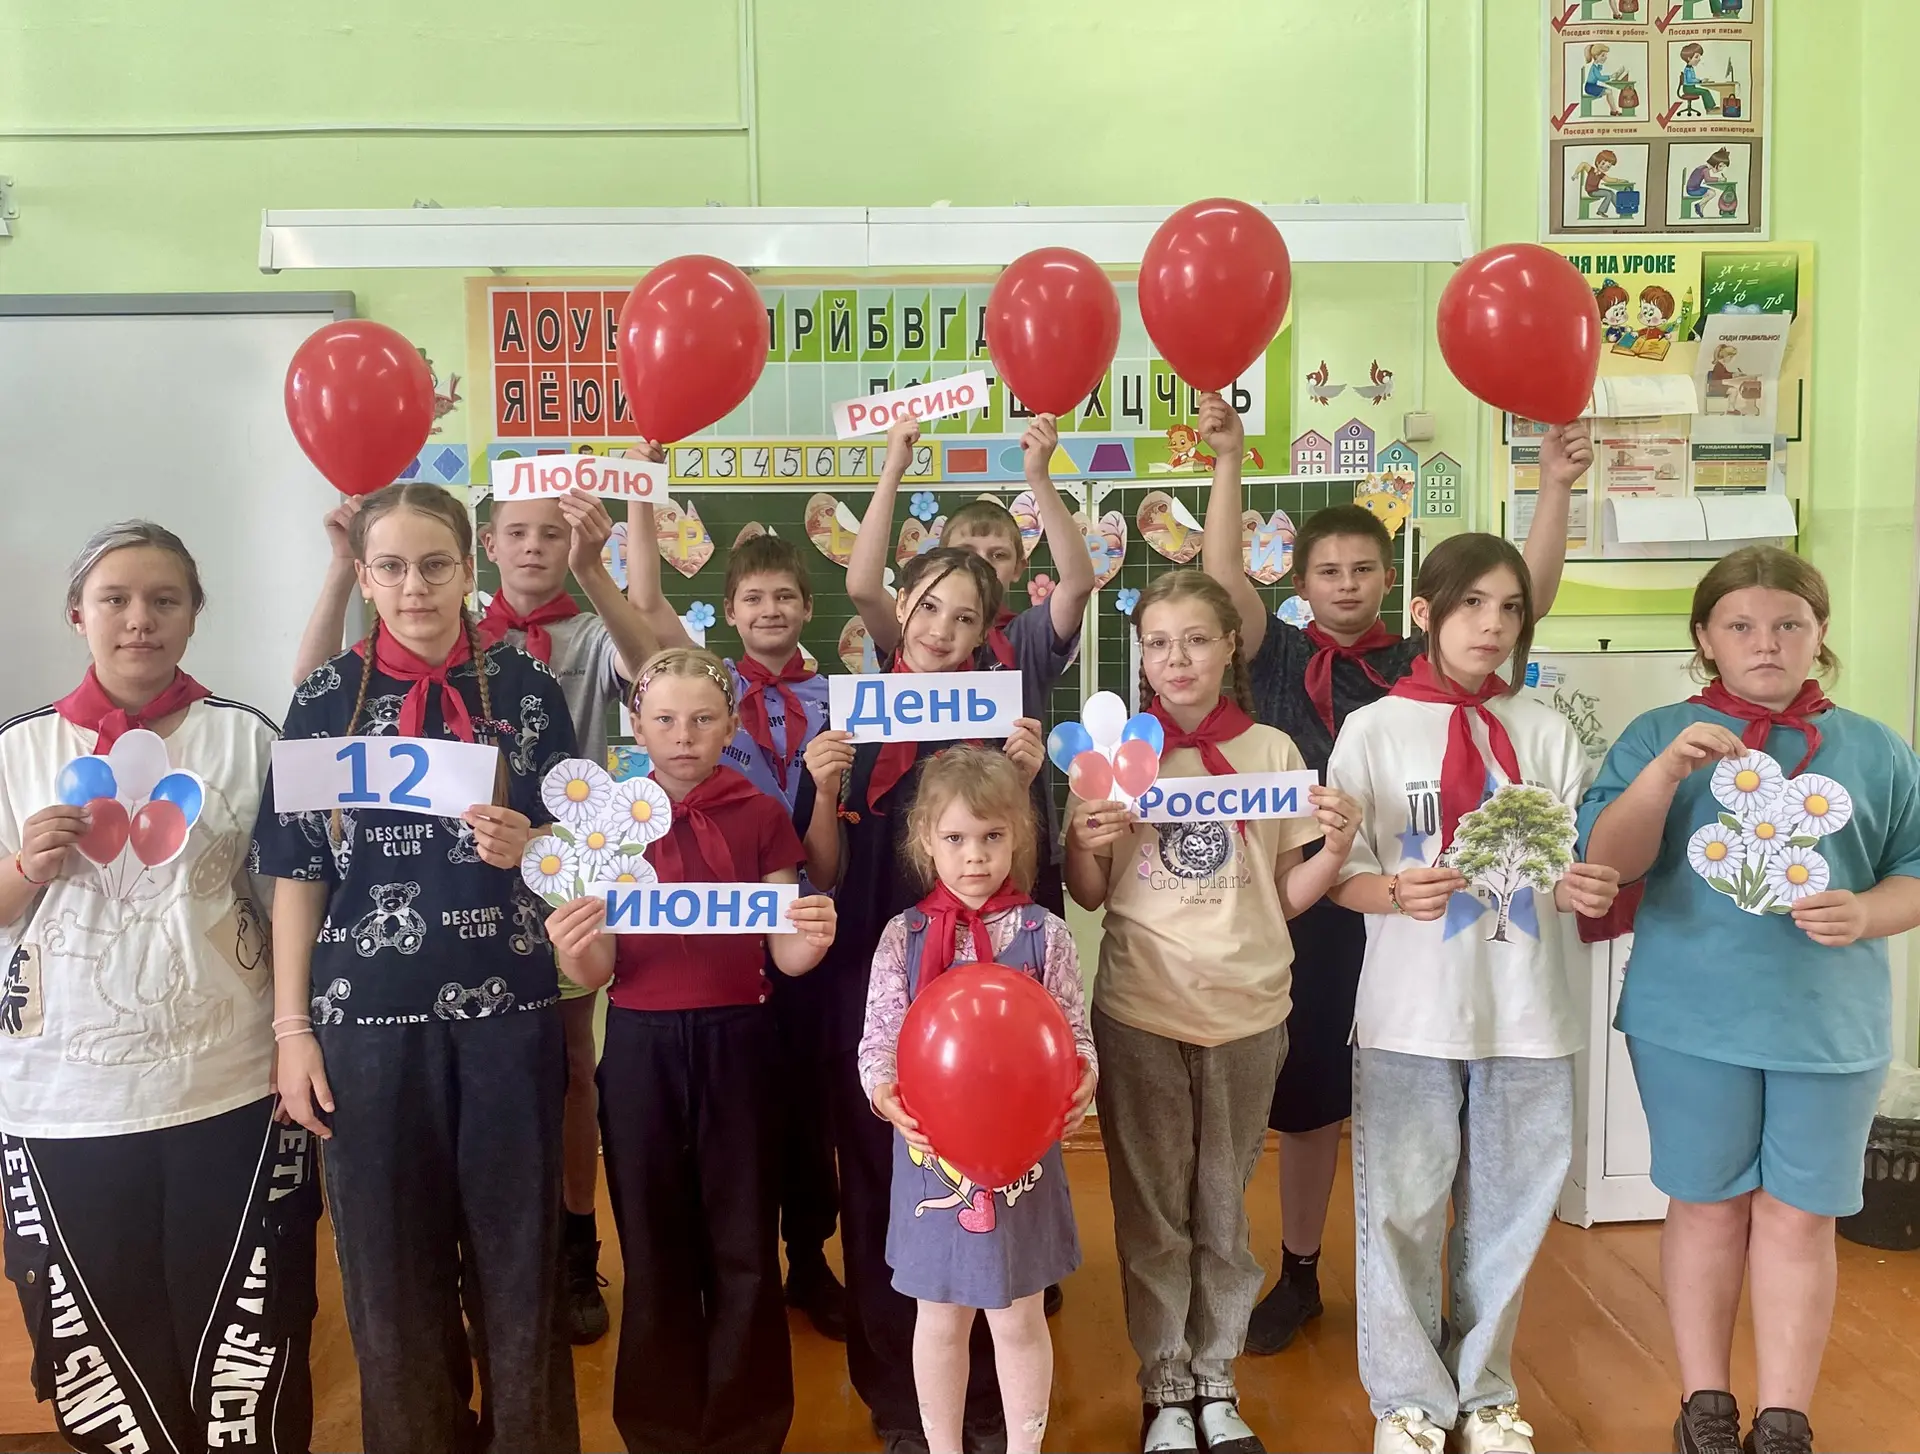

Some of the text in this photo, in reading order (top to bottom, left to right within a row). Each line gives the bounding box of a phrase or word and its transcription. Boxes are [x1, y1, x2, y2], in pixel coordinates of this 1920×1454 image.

[1561, 29, 1591, 37] Посадка
[1668, 28, 1699, 36] Посадка
[1563, 128, 1594, 136] Посадка
[1597, 127, 1610, 136] при
[1666, 125, 1697, 133] Посадка
[1596, 255, 1618, 274] НА
[1623, 254, 1676, 274] УРОКЕ
[500, 308, 527, 353] А
[536, 308, 562, 353] О
[794, 307, 815, 351] Р
[829, 298, 851, 353] Й
[867, 306, 889, 351] Б
[904, 307, 925, 350] В
[939, 307, 958, 350] Г
[1718, 334, 1781, 342] СИДИ ПРАВИЛЬНО!
[503, 379, 526, 423] Я
[539, 372, 561, 422] Ё
[572, 378, 602, 423] Ю
[1121, 375, 1144, 425] Ц
[1156, 374, 1177, 416] Ч
[846, 384, 975, 432] Россию
[684, 446, 933, 478] 2 3 4 5 6 7 9
[508, 457, 653, 498] Люблю
[845, 680, 998, 736] День
[335, 741, 432, 809] 12
[1139, 786, 1298, 819] России
[365, 823, 434, 843] DESCHPE
[382, 840, 423, 857] CLUB
[1148, 870, 1188, 891] Got
[1179, 896, 1222, 905] Follow me
[458, 922, 499, 940] CLUB
[1006, 1170, 1035, 1194] LOVE
[207, 1322, 277, 1449] SINCE
